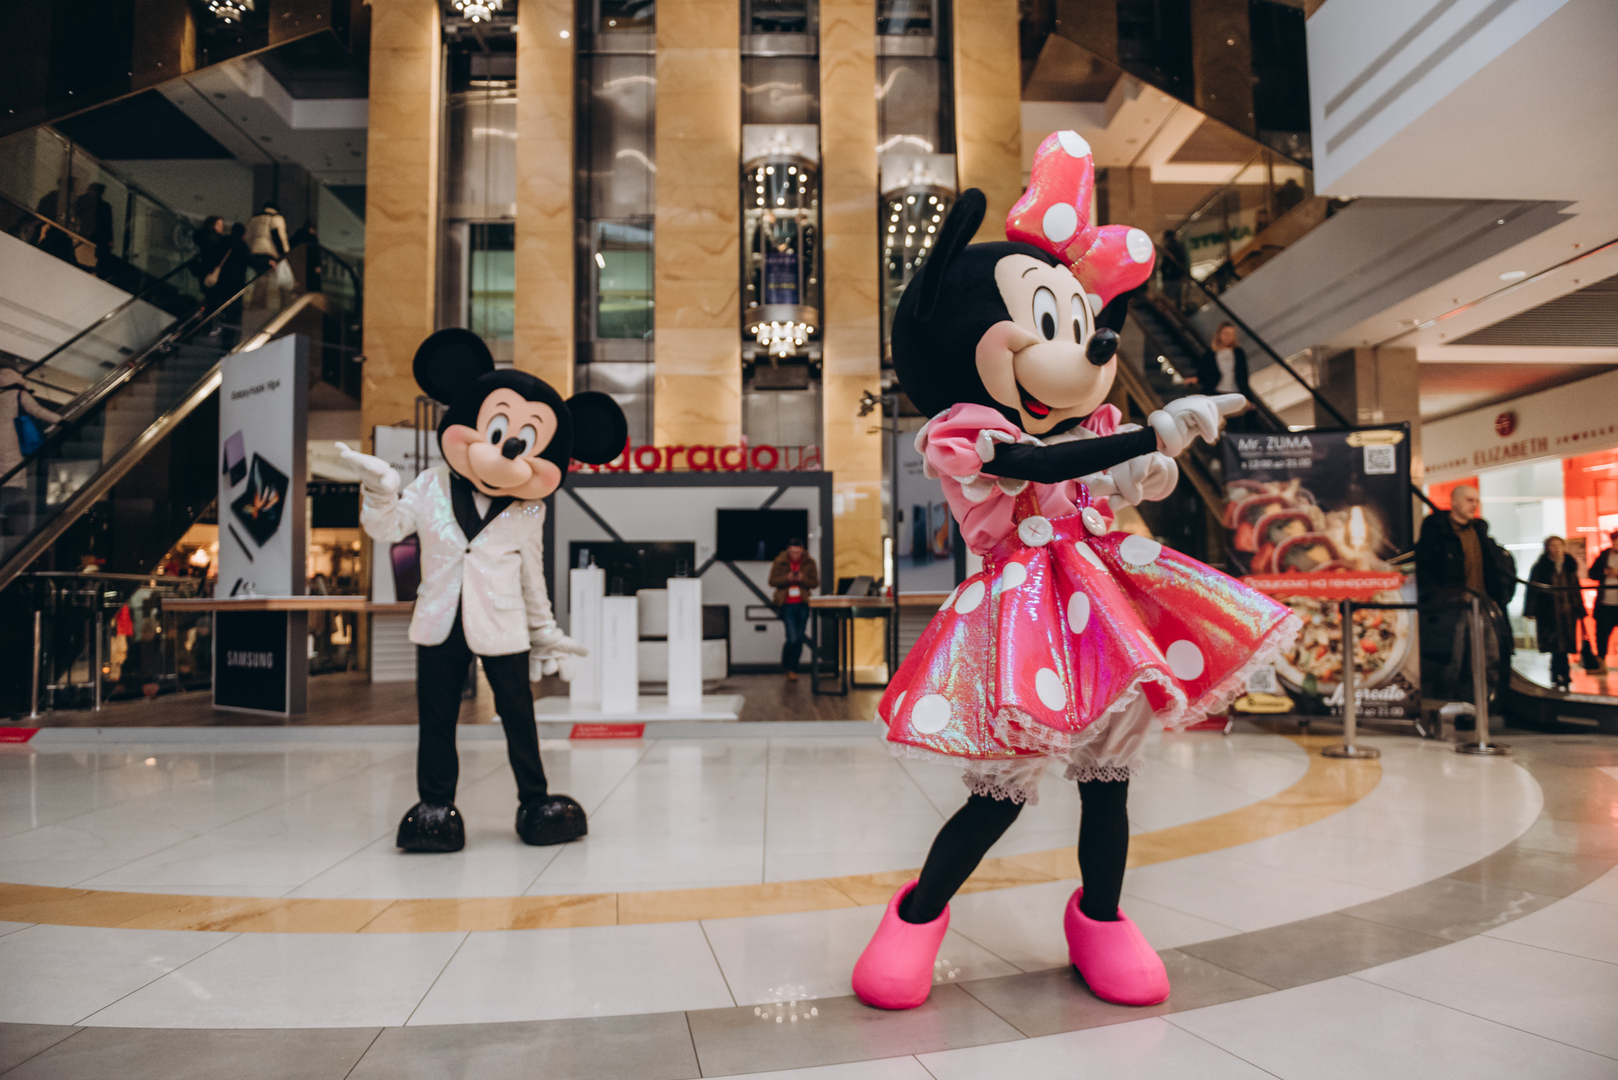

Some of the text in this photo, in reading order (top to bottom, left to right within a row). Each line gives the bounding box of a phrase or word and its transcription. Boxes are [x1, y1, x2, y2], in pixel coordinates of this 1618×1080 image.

[1266, 436, 1313, 451] ZUMA
[1556, 424, 1618, 445] JEWELLE
[568, 434, 779, 472] dorado
[1473, 436, 1548, 467] ELIZABETH
[1311, 579, 1327, 588] на
[226, 650, 273, 669] SAMSUNG
